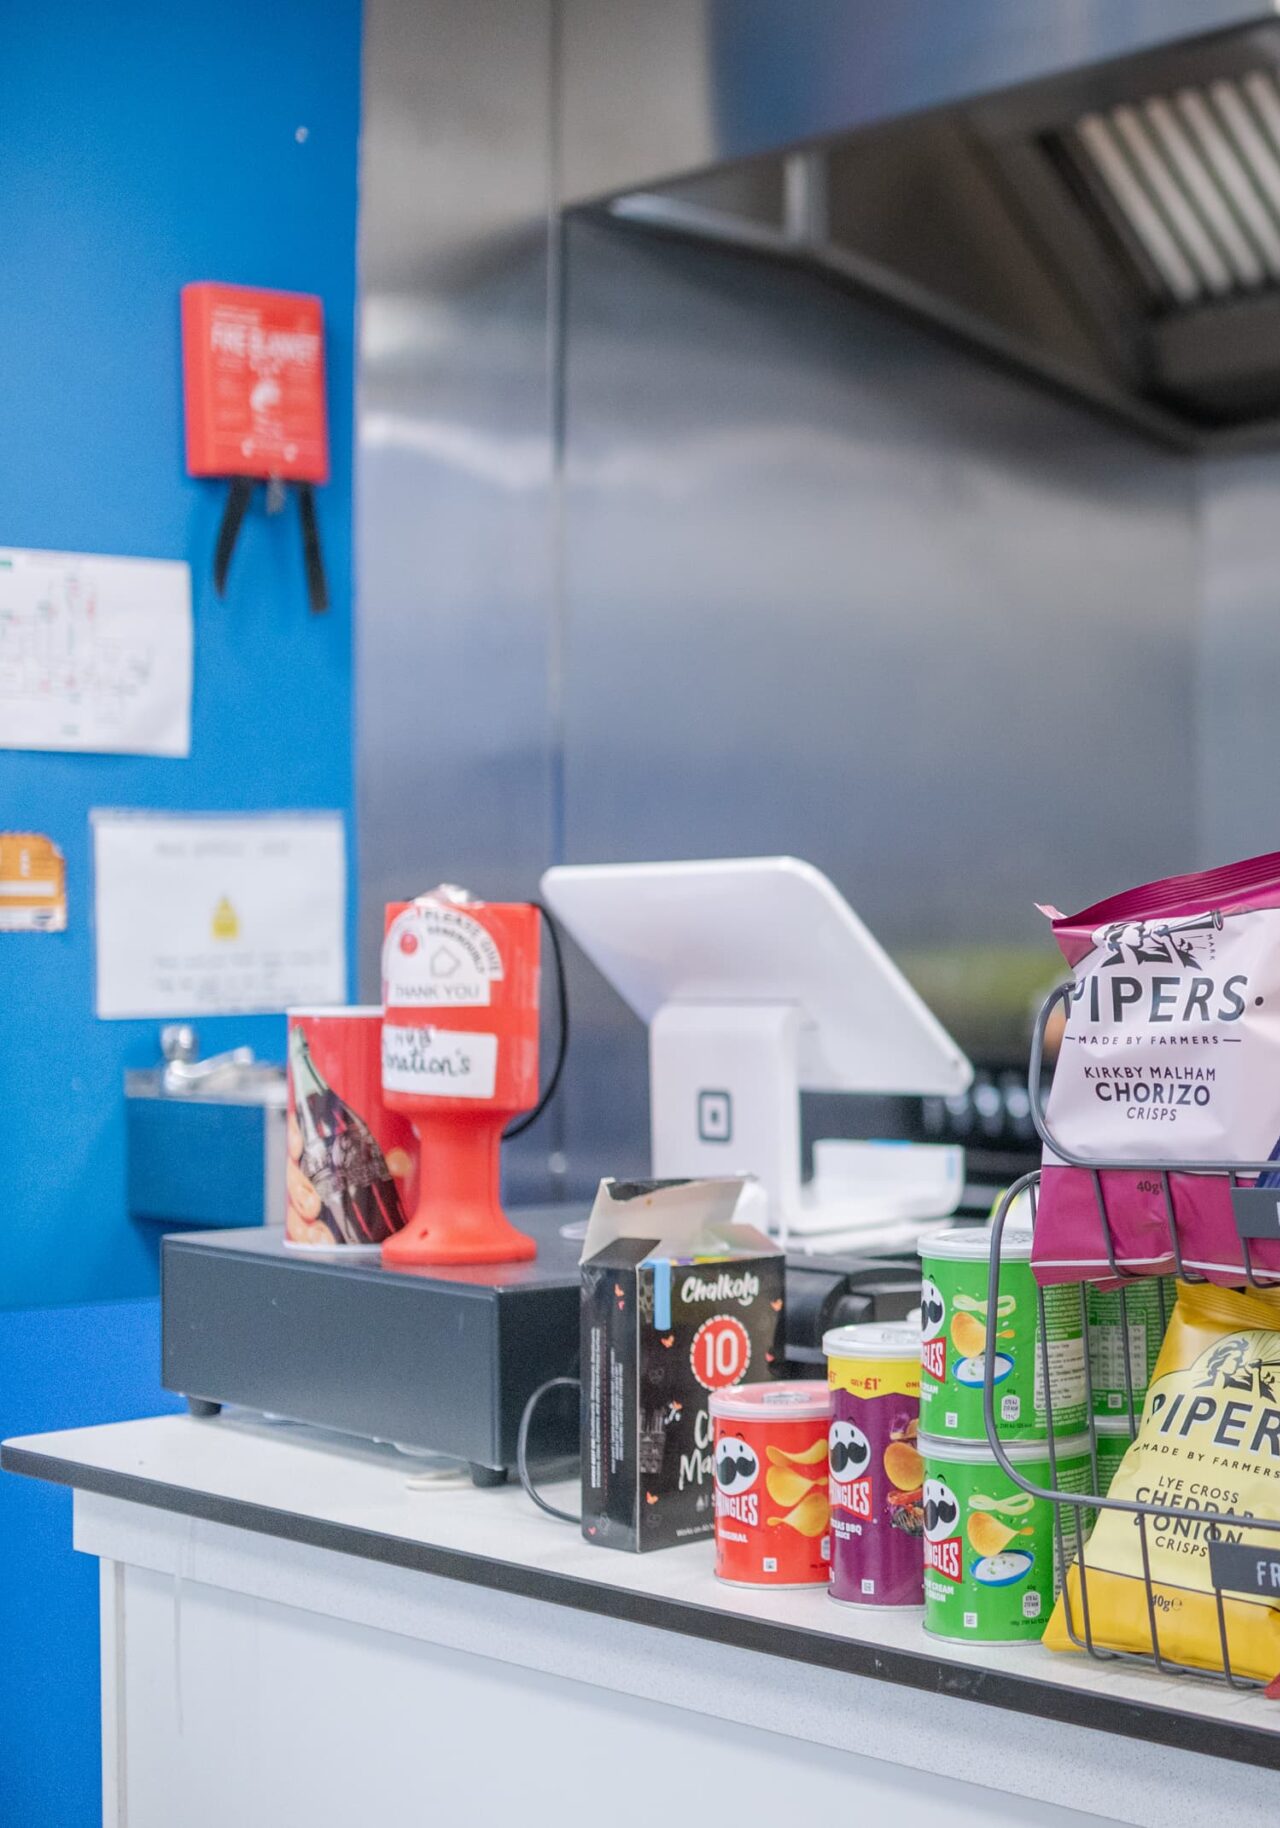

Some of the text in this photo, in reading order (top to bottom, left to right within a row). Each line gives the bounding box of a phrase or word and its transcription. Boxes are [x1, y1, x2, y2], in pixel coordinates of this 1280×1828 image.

[444, 983, 480, 999] YOU
[1078, 1035, 1220, 1046] MADE BY FARMERS
[1084, 1065, 1217, 1082] KIRKBY MALHAM
[1095, 1082, 1211, 1107] CHORIZO
[1126, 1105, 1178, 1122] CRISPS
[1136, 1179, 1161, 1196] 40g
[681, 1272, 760, 1306] Chalkola
[704, 1329, 739, 1378] 10
[1141, 1442, 1179, 1457] MADE
[1186, 1450, 1204, 1462] BY
[1158, 1475, 1240, 1505] LYE CROSS
[1152, 1514, 1244, 1545] ONION
[1154, 1535, 1208, 1558] CRISPS
